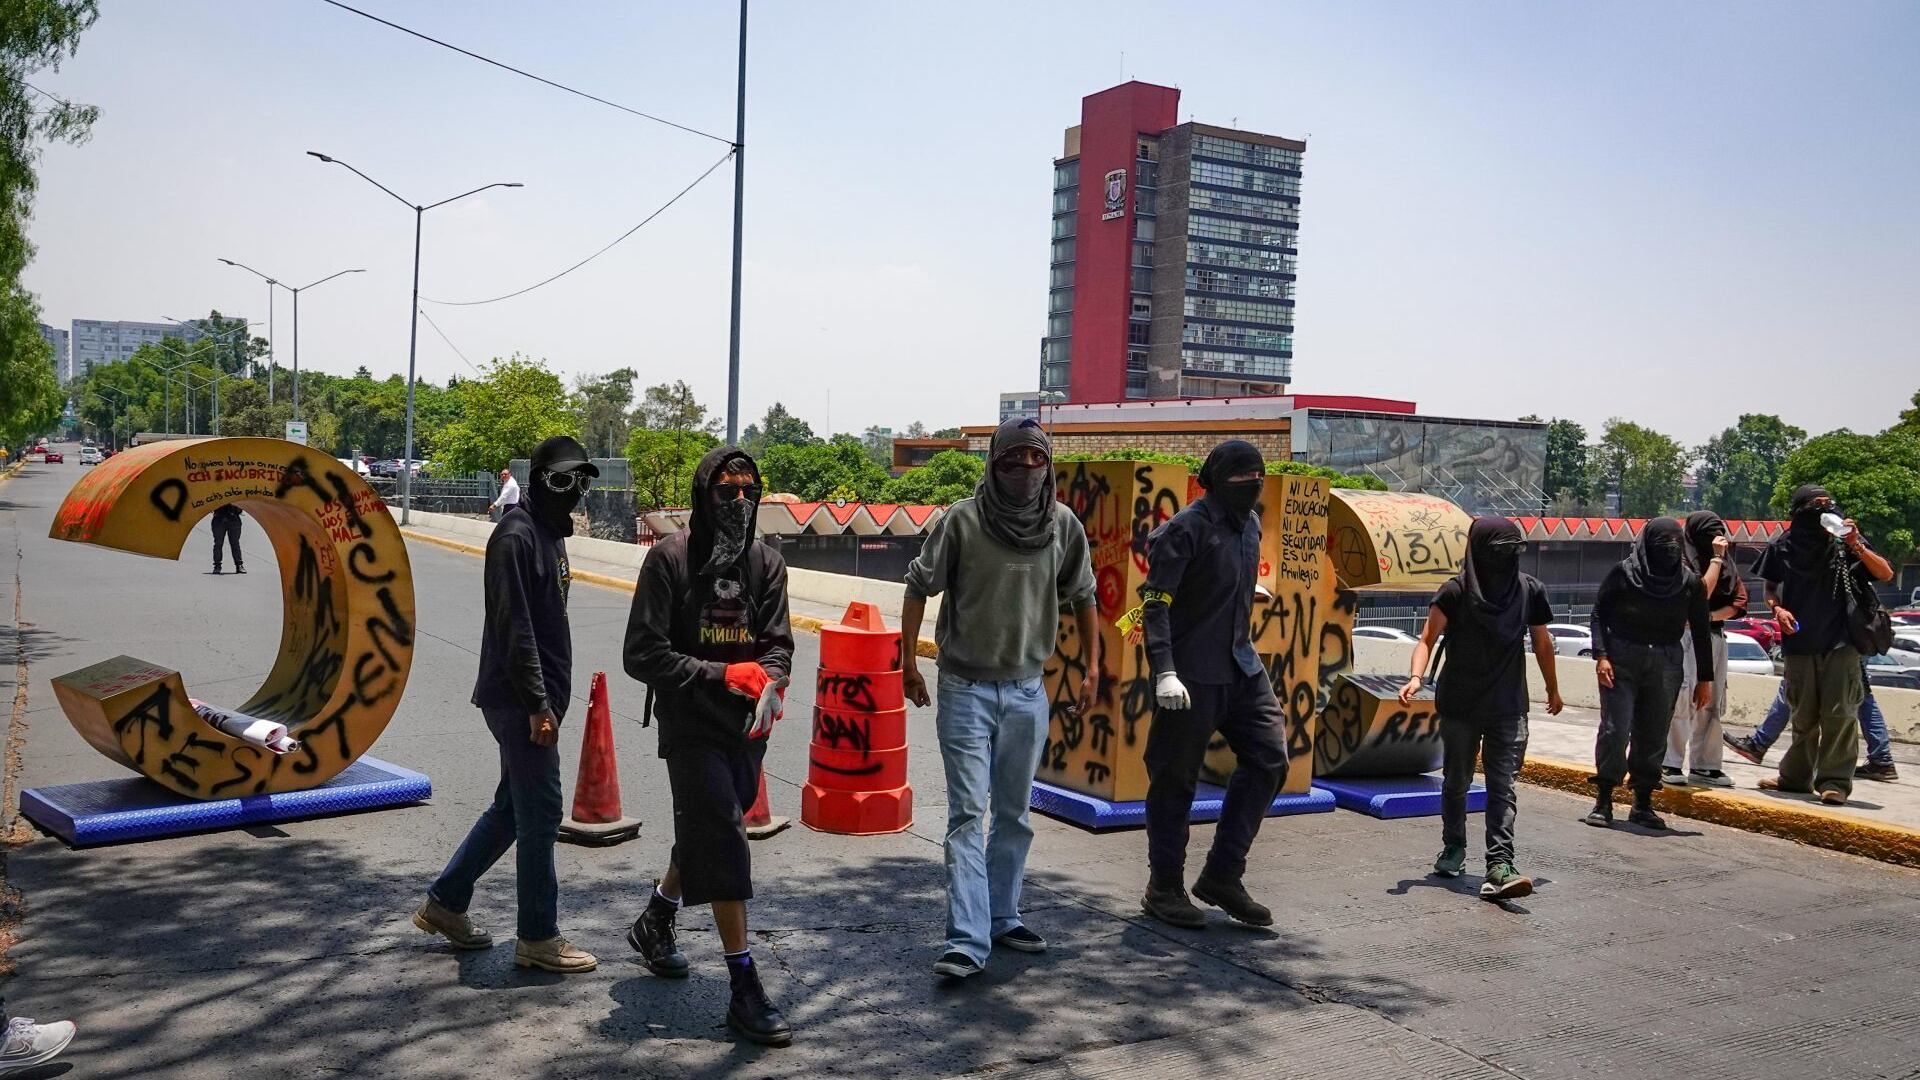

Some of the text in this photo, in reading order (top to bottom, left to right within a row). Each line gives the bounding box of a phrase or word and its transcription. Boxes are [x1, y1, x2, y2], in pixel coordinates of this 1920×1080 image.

[1289, 481, 1320, 498] NI LA
[1282, 517, 1311, 534] NI LA
[331, 526, 362, 543] MAL
[1282, 549, 1299, 561] ES
